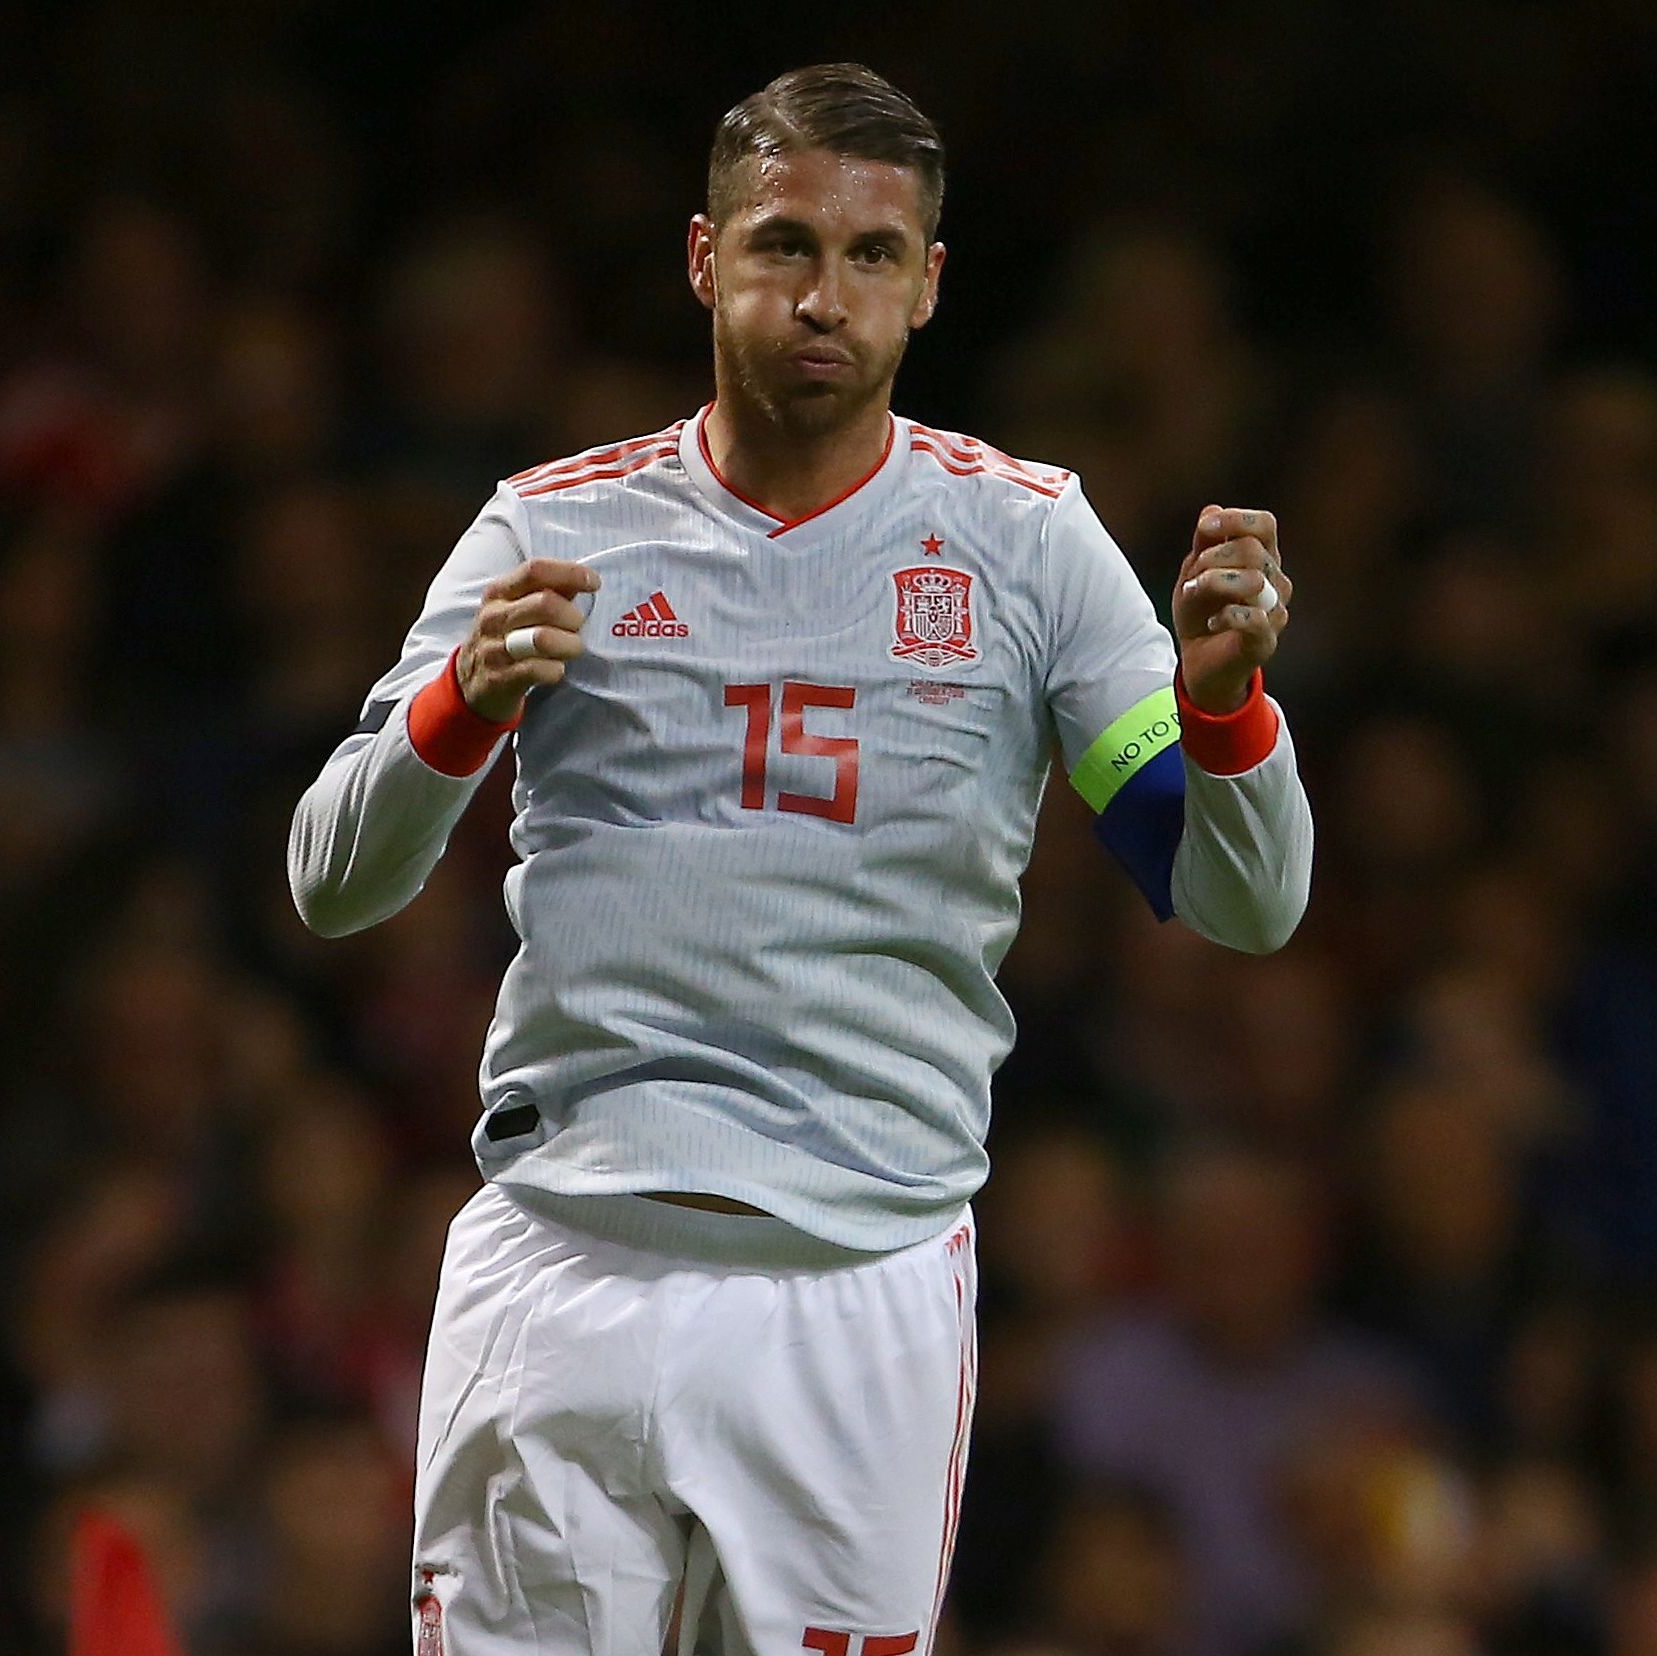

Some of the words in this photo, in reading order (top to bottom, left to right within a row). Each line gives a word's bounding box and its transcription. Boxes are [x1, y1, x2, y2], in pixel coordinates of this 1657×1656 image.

[611, 619, 690, 638] adidas
[724, 681, 859, 825] 15
[1110, 742, 1141, 773] NO
[1139, 721, 1170, 744] TO
